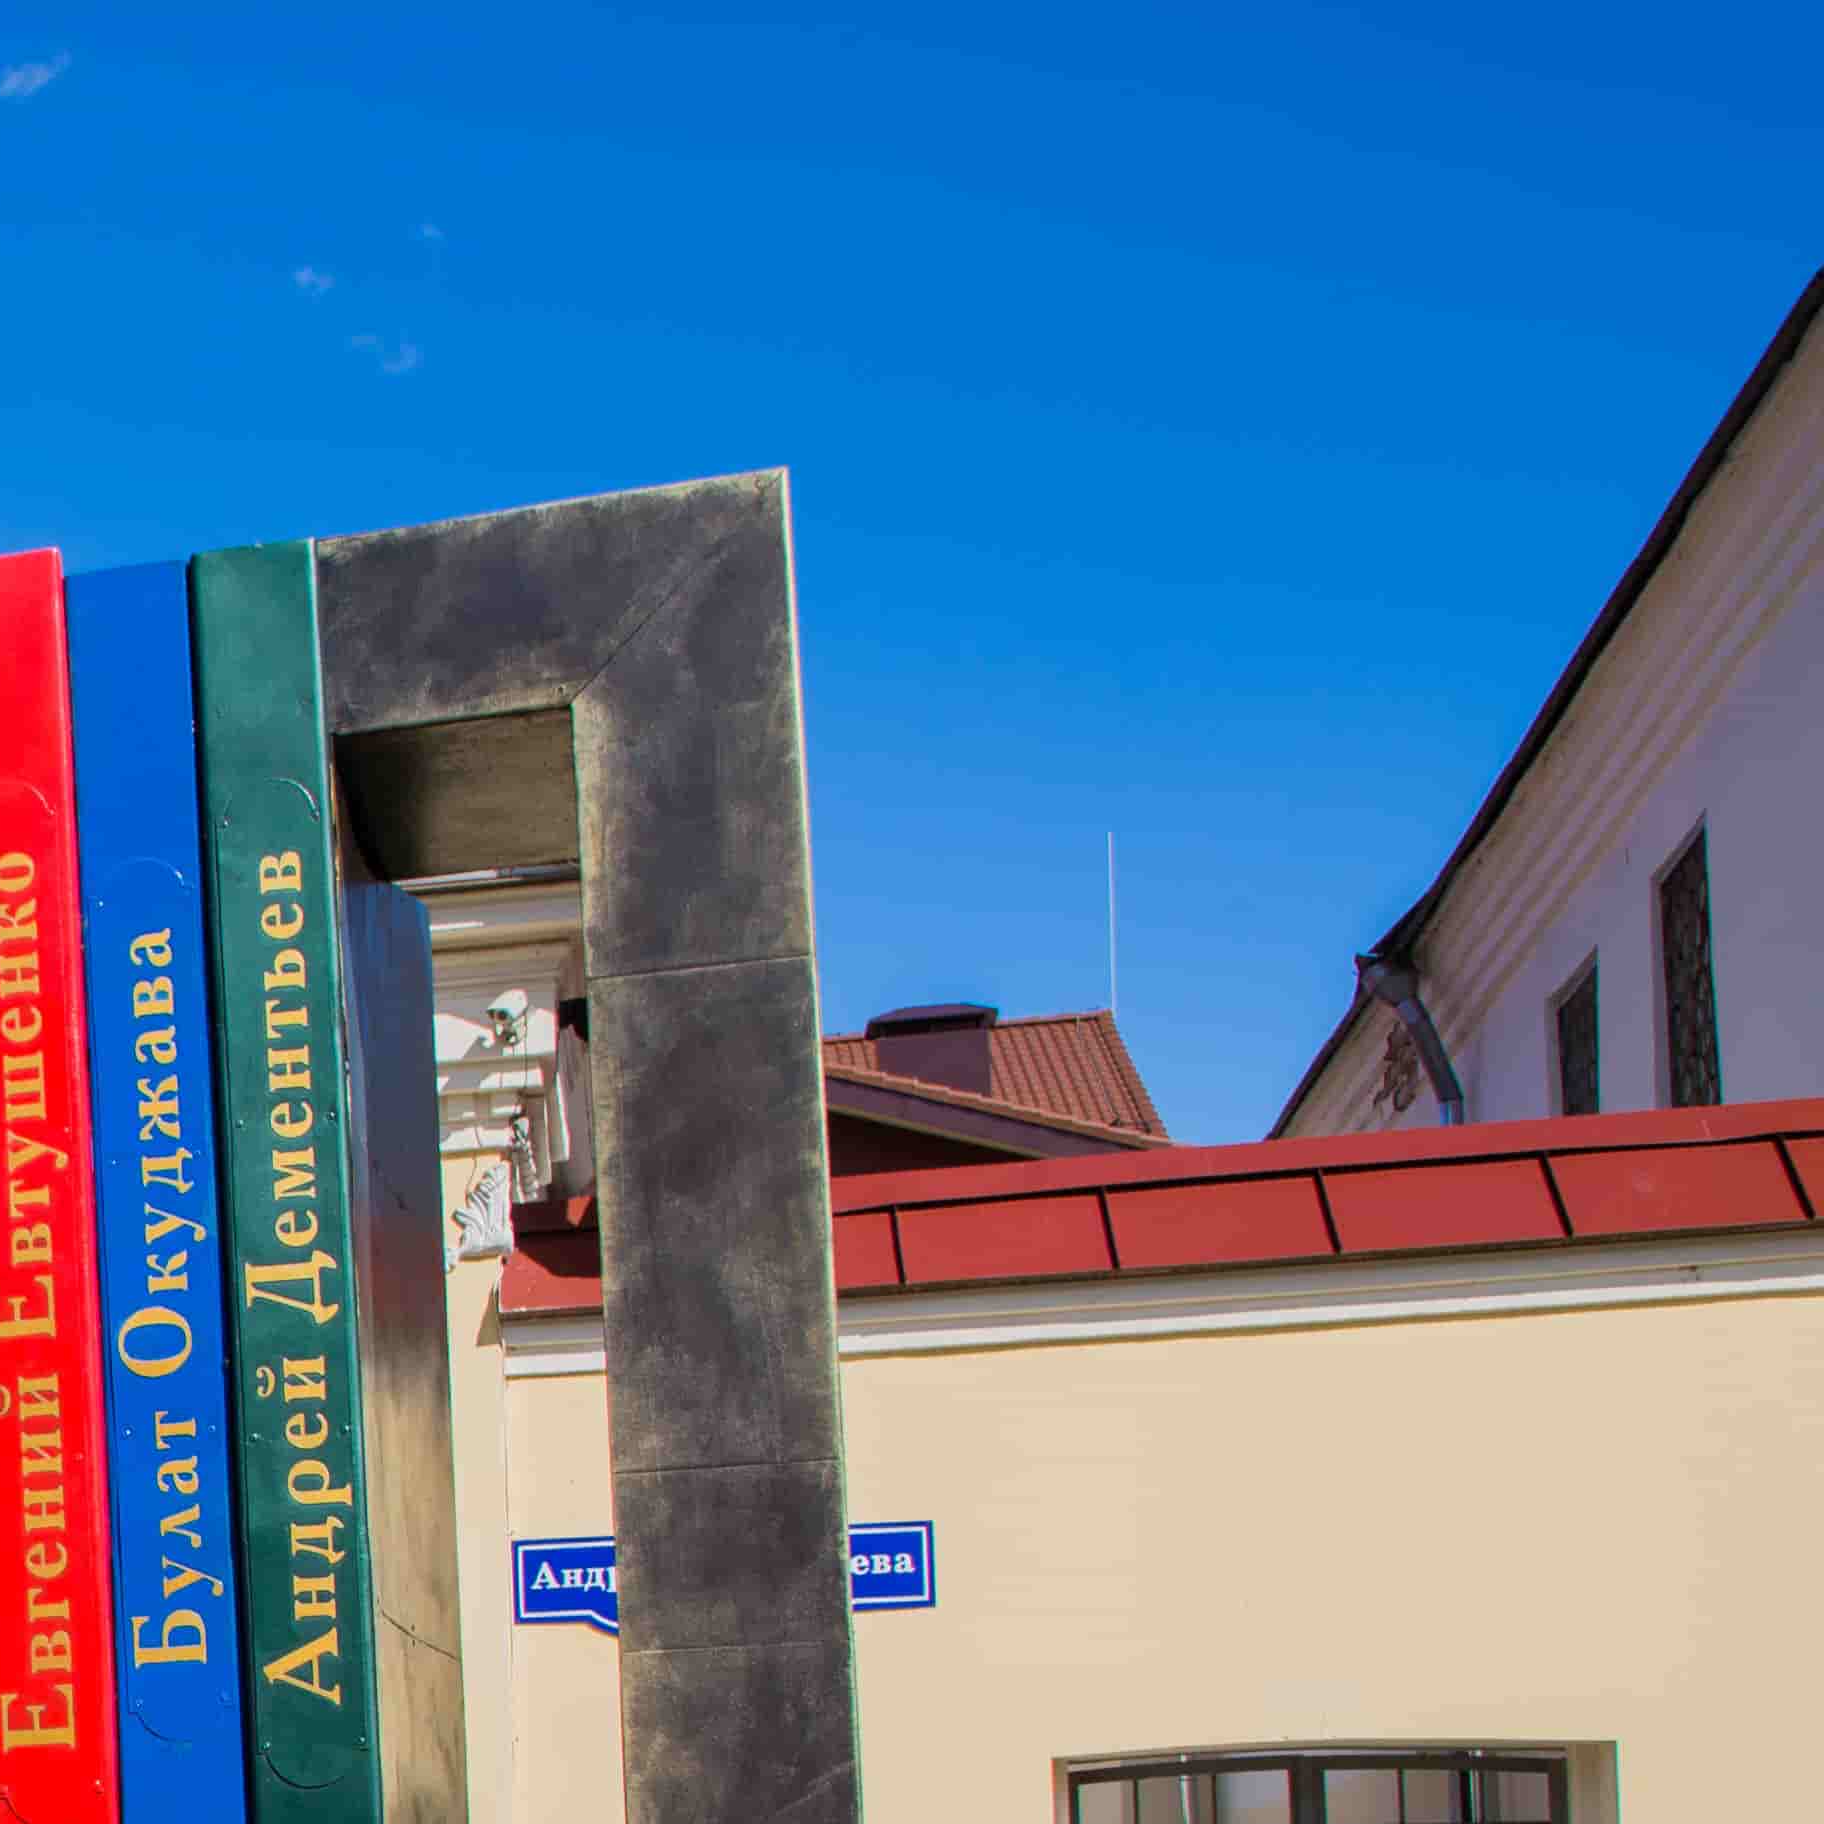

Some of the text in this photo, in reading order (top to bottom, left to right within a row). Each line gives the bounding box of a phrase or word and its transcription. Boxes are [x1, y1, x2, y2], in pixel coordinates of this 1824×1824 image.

[117, 927, 224, 1667] Булат Окуджава
[245, 848, 353, 1705] Андрей Дементьев
